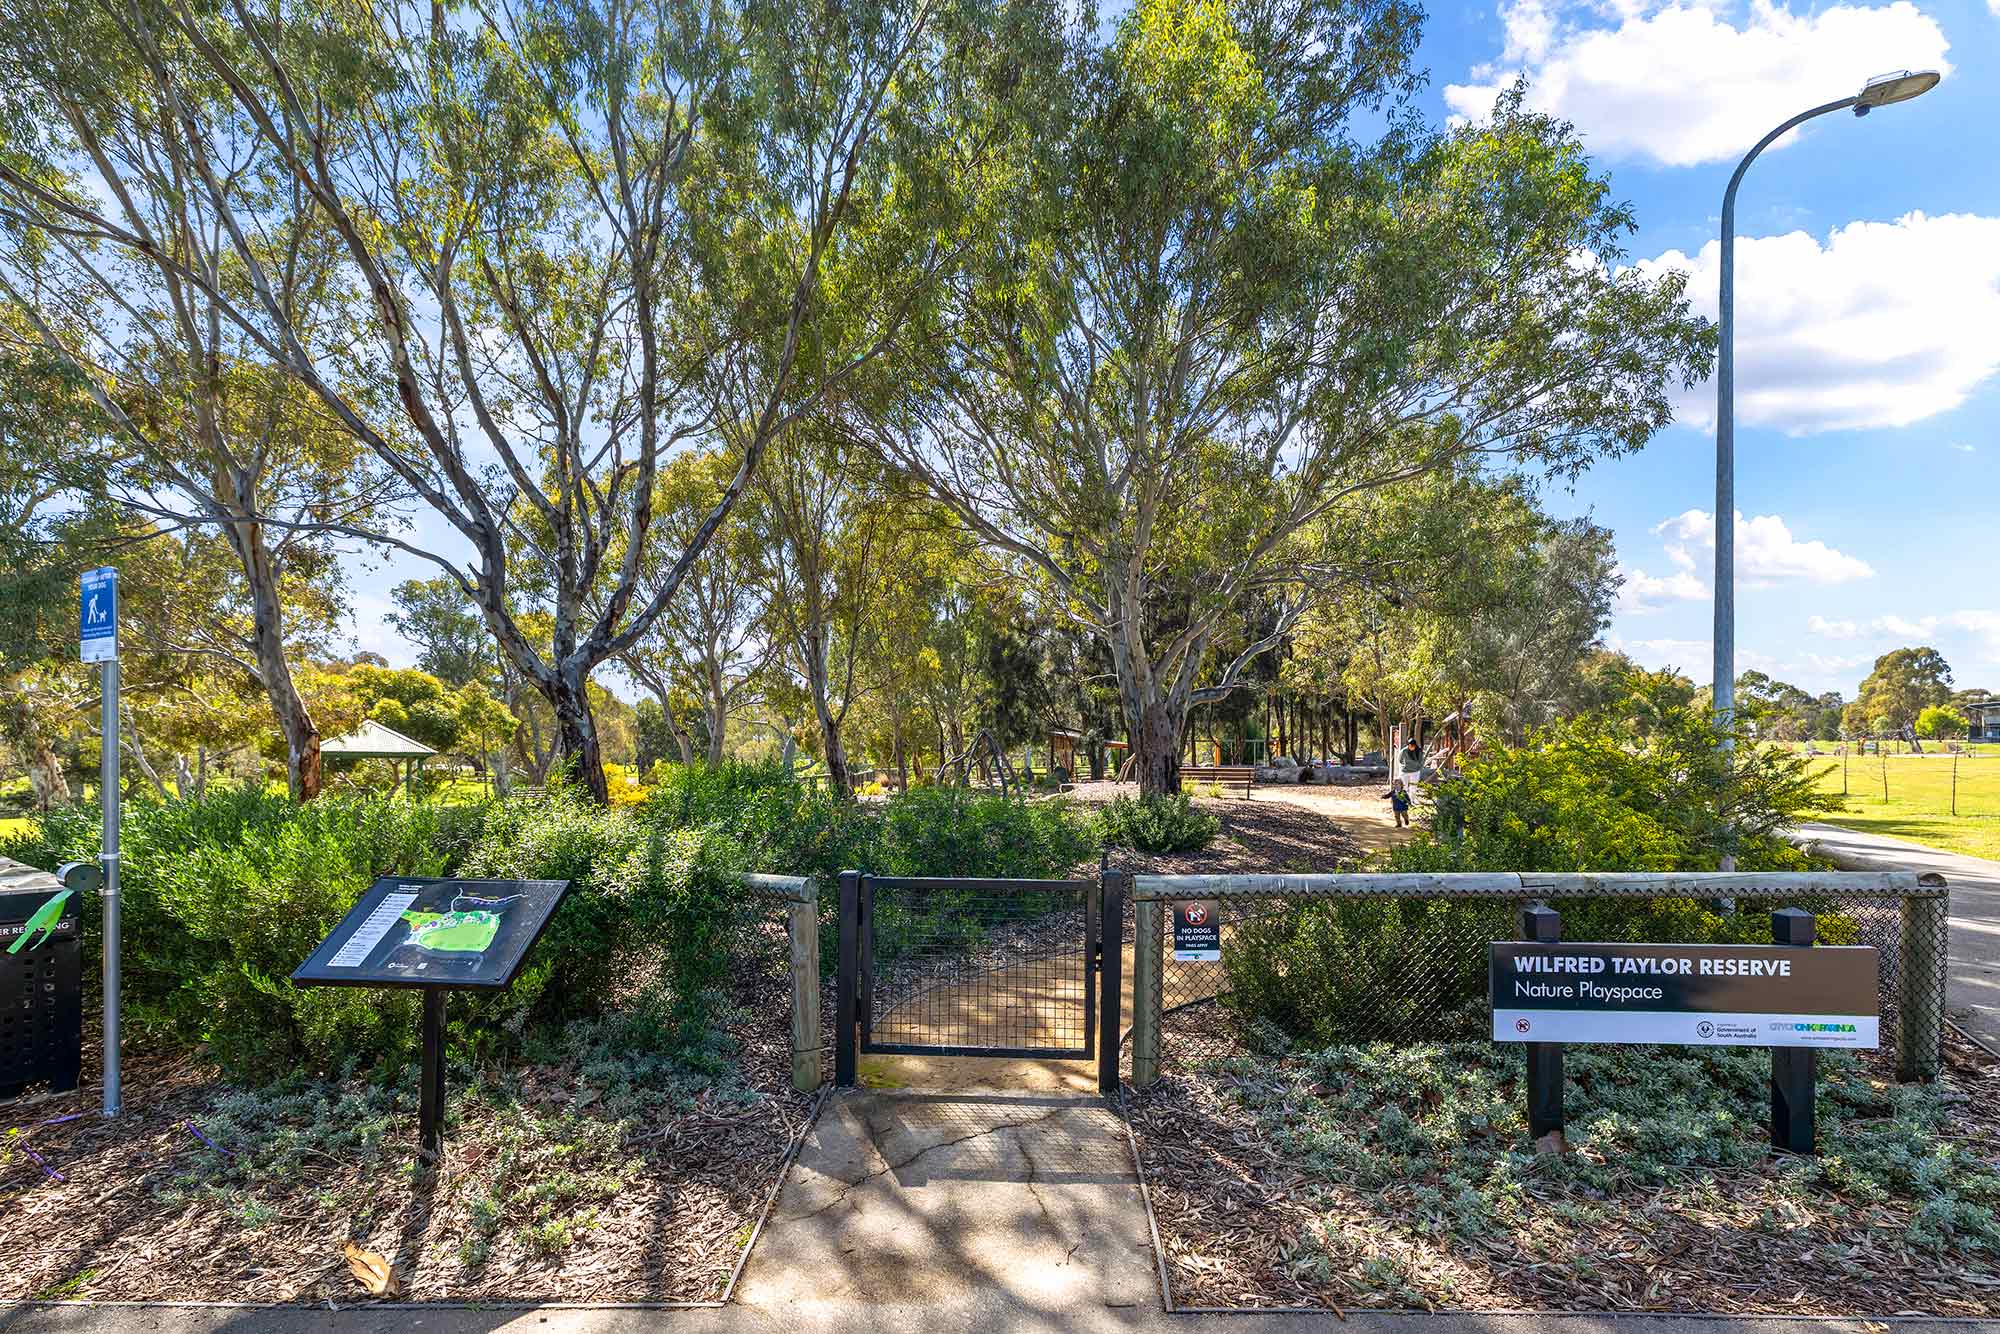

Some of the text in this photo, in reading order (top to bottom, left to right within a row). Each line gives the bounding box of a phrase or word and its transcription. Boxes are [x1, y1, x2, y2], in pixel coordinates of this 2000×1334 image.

[1513, 956, 1791, 977] WILFRED TAYLOR RESERVE
[1514, 980, 1663, 1003] Nature Playspace
